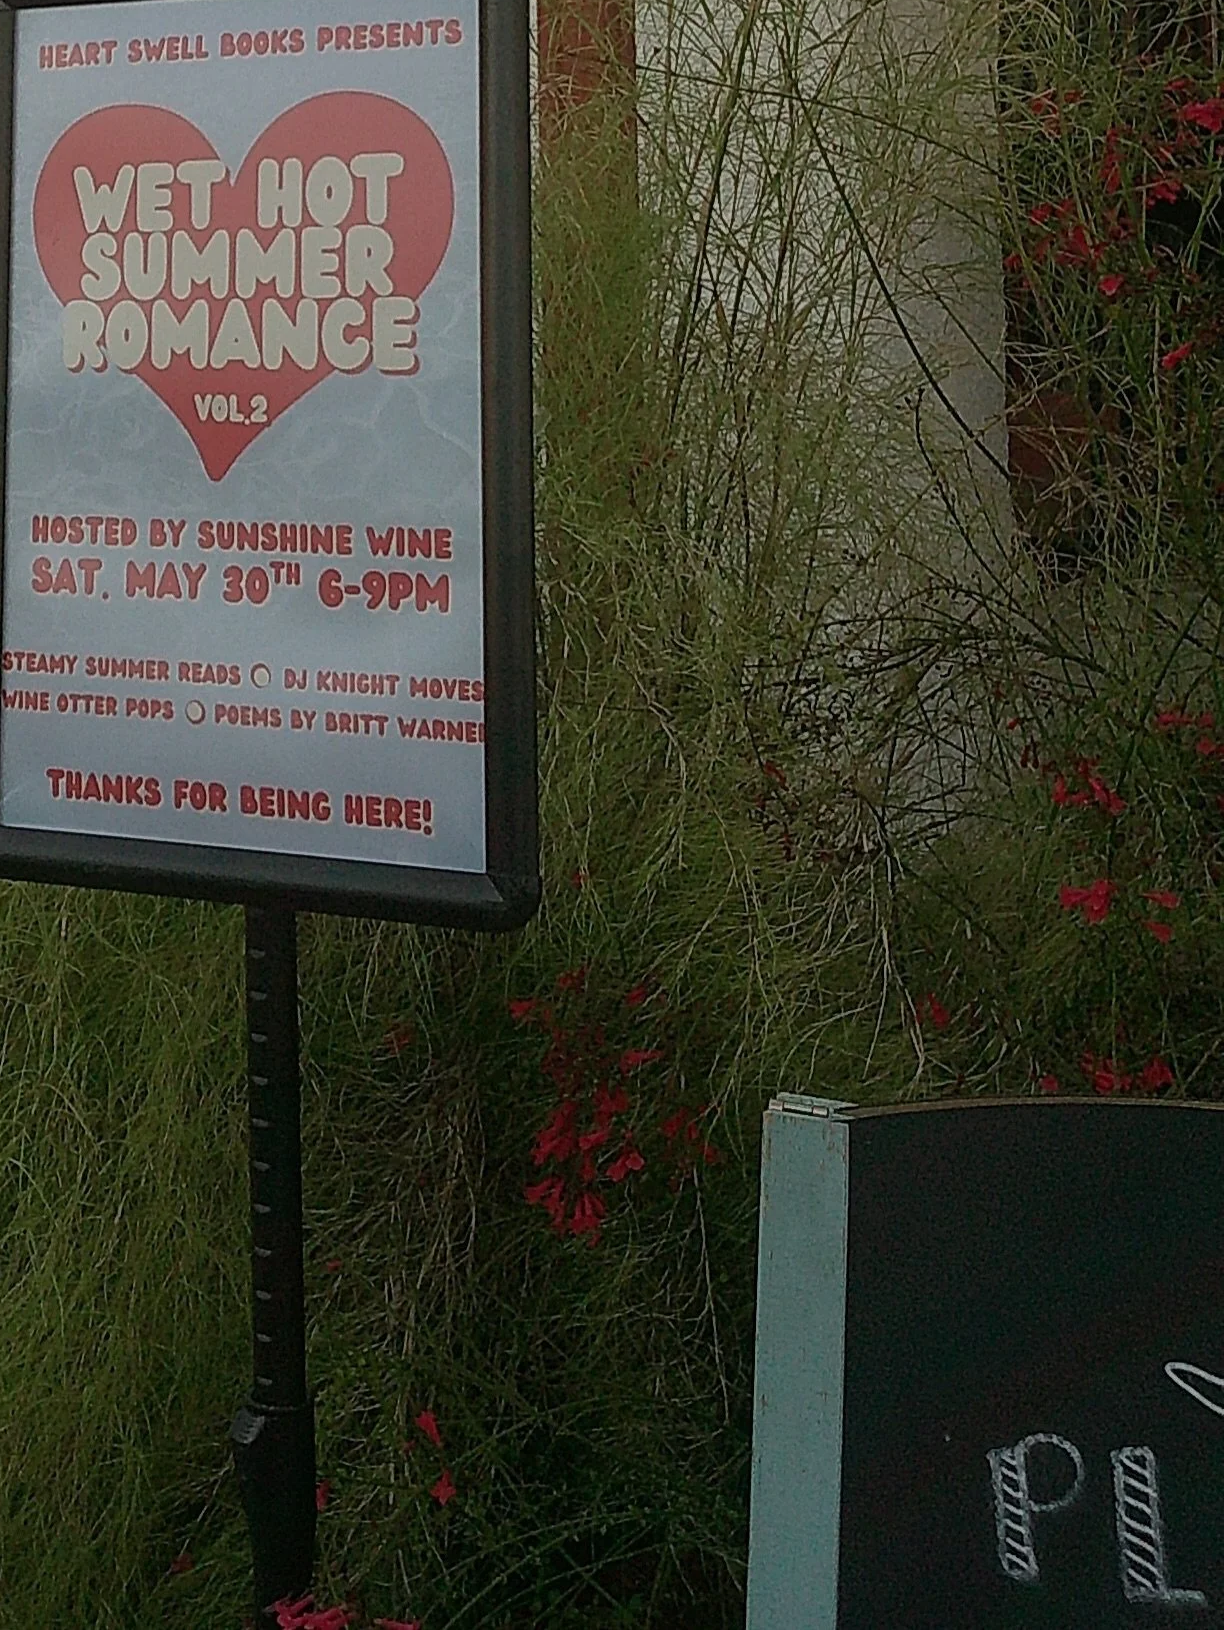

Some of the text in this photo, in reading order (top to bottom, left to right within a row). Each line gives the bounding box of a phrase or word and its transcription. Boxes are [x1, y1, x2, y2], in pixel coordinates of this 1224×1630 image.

[39, 18, 462, 69] HEART SWELL BOOKS PRESENTS
[73, 152, 405, 233] WET HOT
[80, 224, 395, 301] SUMMER
[63, 296, 420, 375] ROMANCE
[31, 514, 453, 560] HOSTED BY SUNSHINE WINE
[31, 556, 111, 601] SAT.
[125, 560, 207, 601] MAY
[318, 569, 450, 613] 6-9PM
[2, 651, 241, 686] STEAMY SUMMER READS
[284, 668, 485, 703] DJ KNIGHT MOVES
[1, 688, 175, 720] WINE OTTER POPS
[214, 703, 282, 729] POEMS
[290, 709, 317, 731] BY
[325, 711, 390, 737] BRITT
[46, 768, 434, 836] THANKS FOR BEING HERE!
